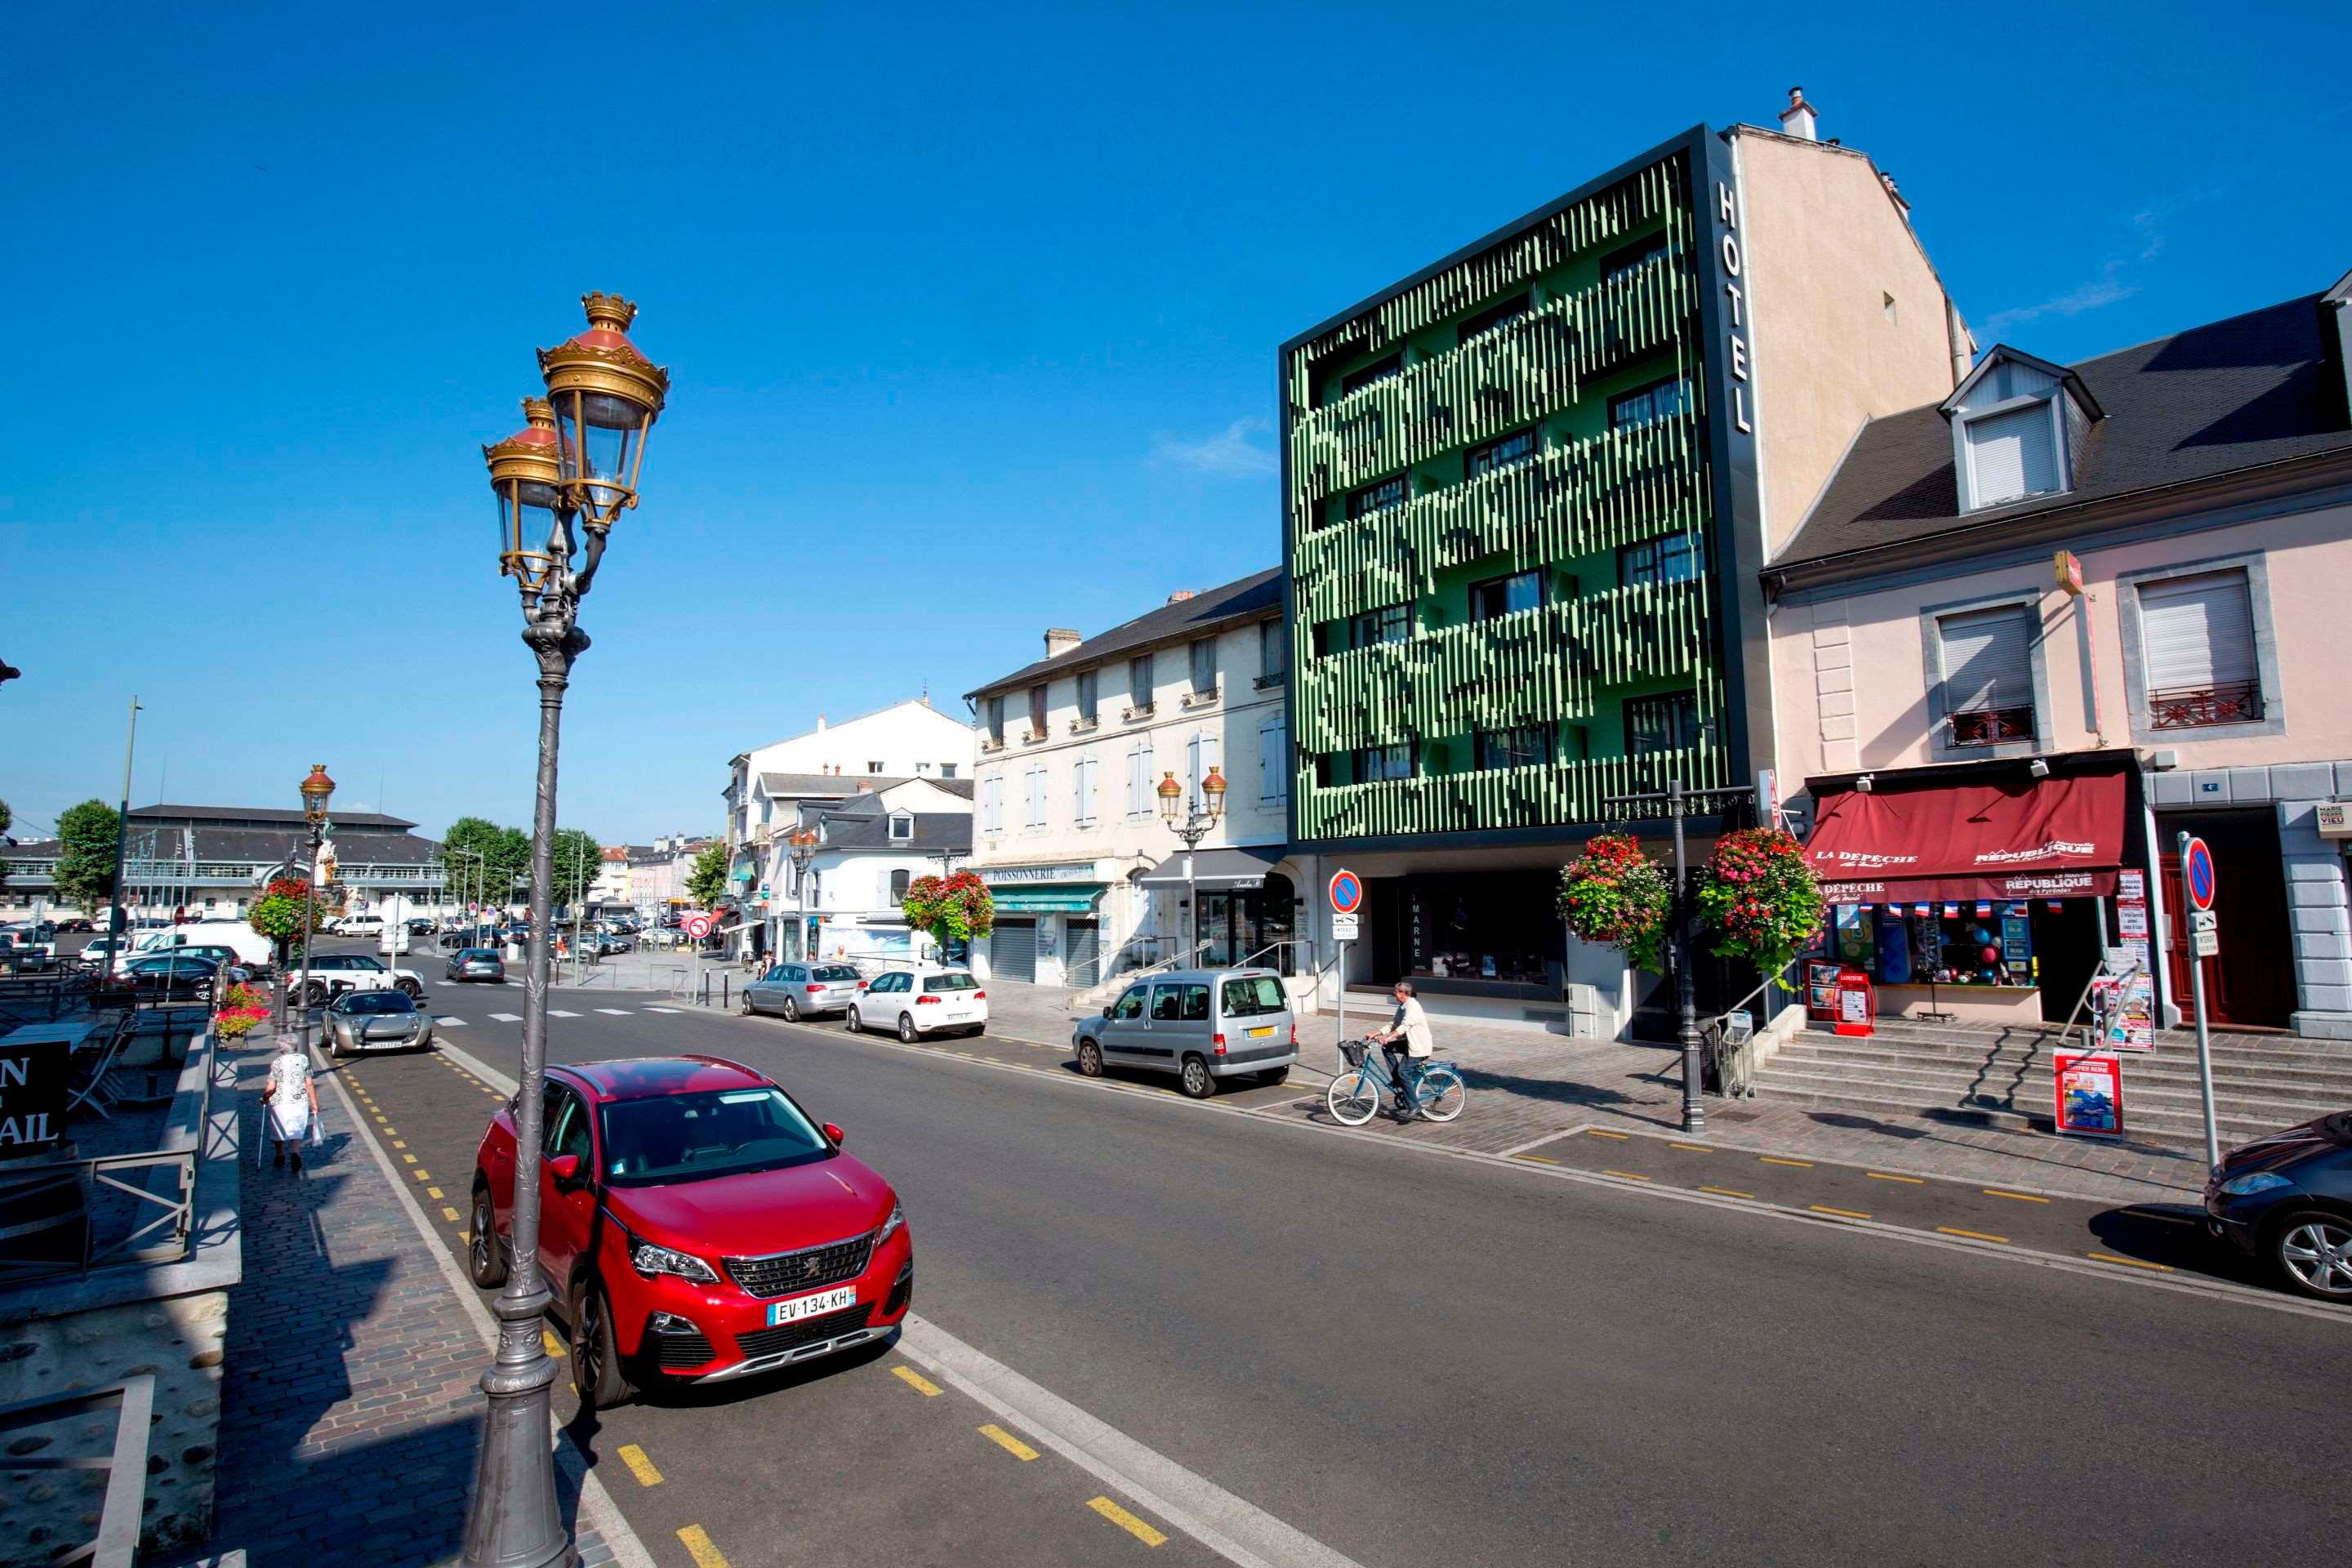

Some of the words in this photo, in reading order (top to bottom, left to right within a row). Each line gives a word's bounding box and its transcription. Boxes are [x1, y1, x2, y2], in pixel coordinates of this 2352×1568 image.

[1717, 180, 1751, 433] HOTEL
[1816, 851, 1835, 859] LA
[993, 867, 1056, 881] POISSONNERIE
[1412, 904, 1421, 957] MARNE
